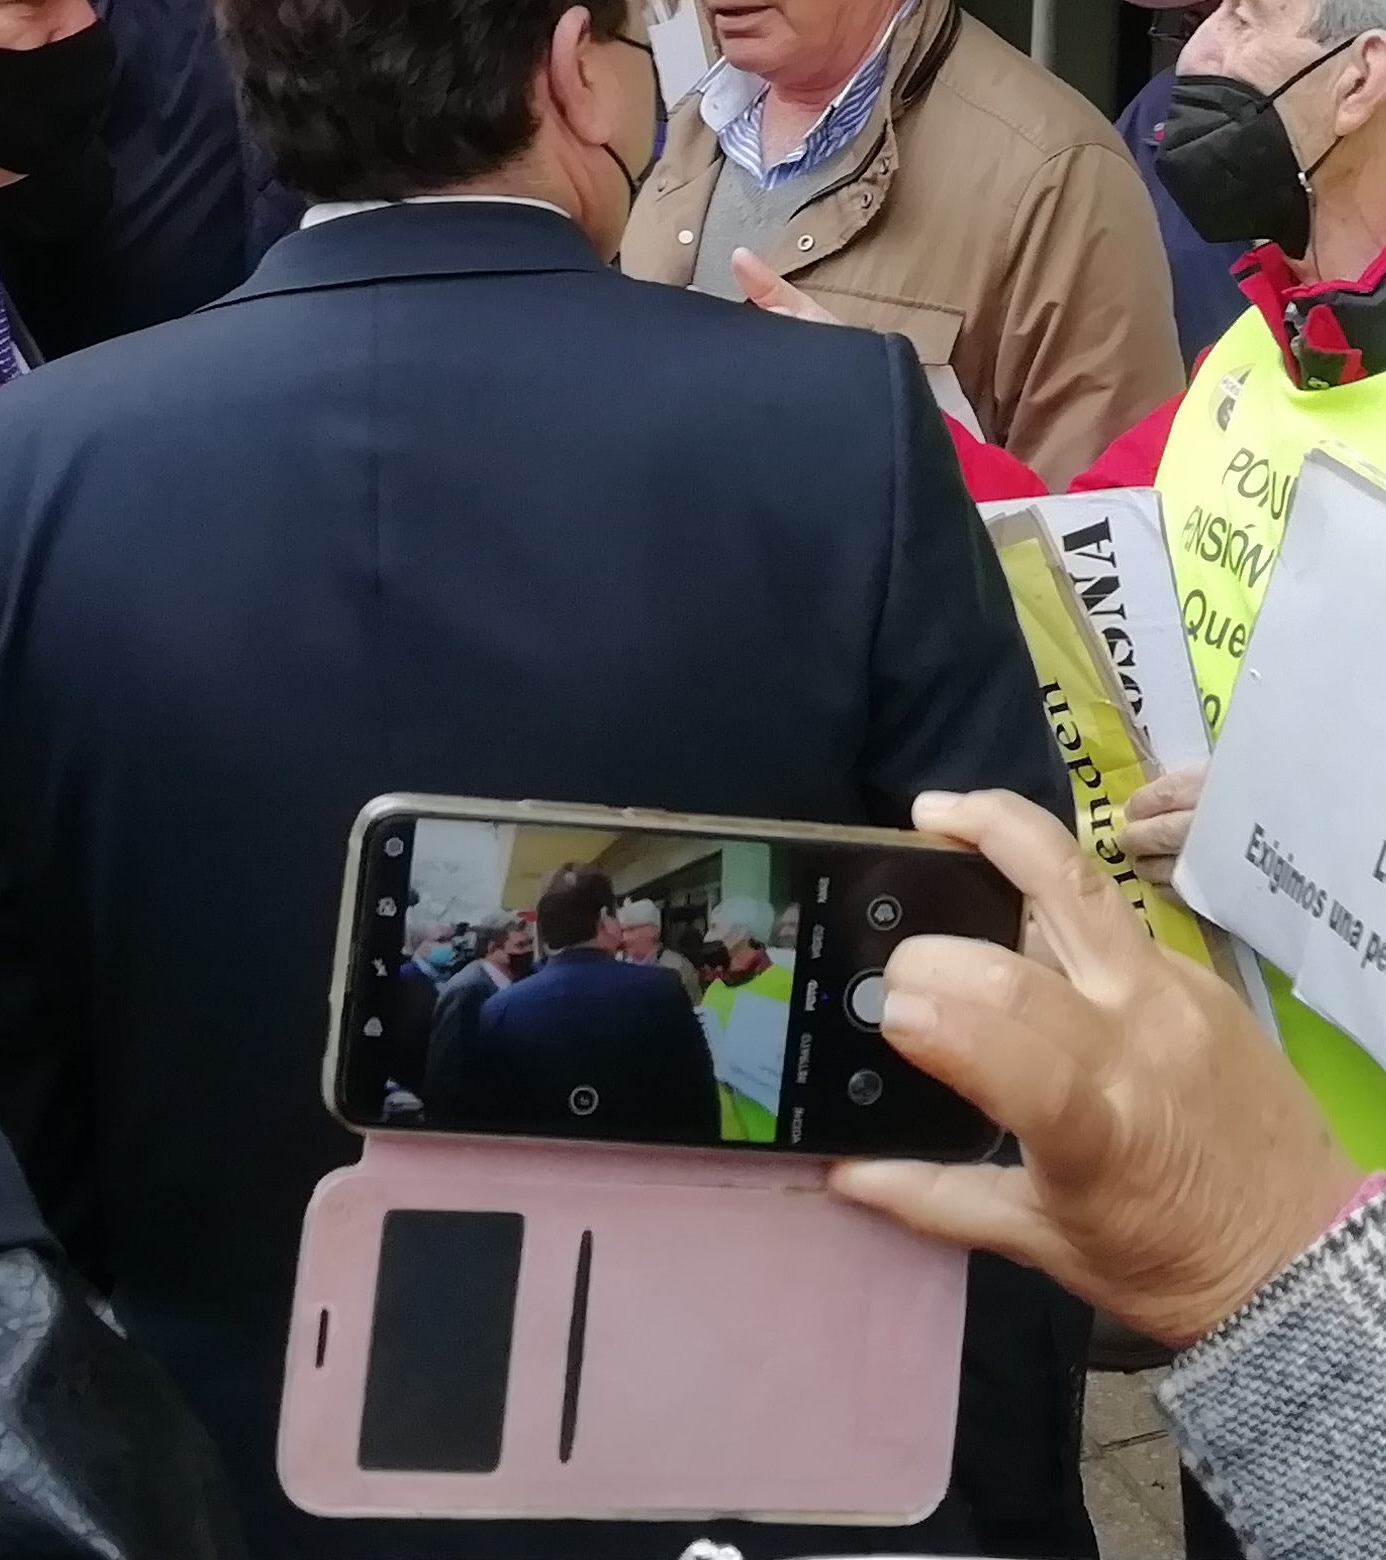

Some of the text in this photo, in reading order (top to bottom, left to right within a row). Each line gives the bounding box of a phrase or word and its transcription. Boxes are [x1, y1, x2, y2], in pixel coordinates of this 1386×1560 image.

[1182, 504, 1276, 588] ENSIÓN
[1182, 588, 1246, 658] Que
[1244, 821, 1328, 919] Exigimos
[1327, 899, 1364, 951] una
